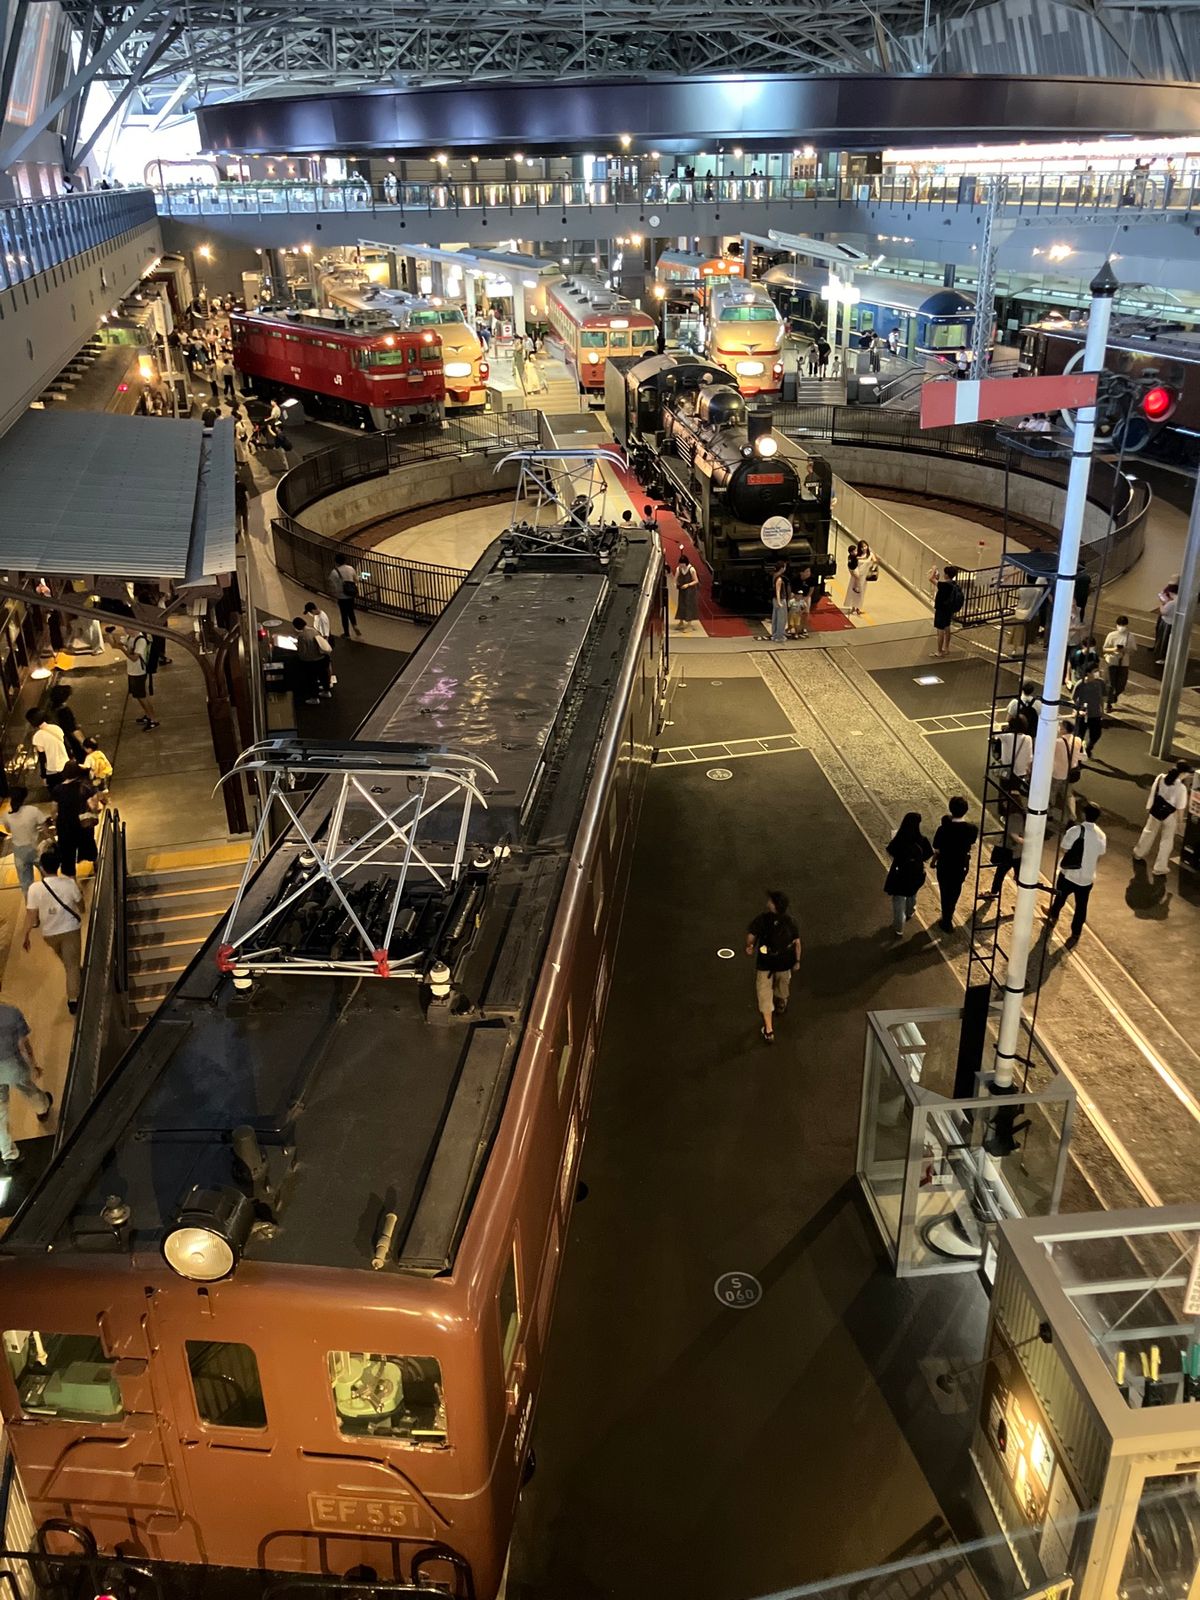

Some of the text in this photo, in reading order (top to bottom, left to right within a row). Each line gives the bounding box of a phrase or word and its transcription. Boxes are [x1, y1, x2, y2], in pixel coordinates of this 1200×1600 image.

[333, 374, 343, 386] JR
[731, 1278, 742, 1288] S
[725, 1289, 754, 1302] 060
[316, 1498, 358, 1522] EF
